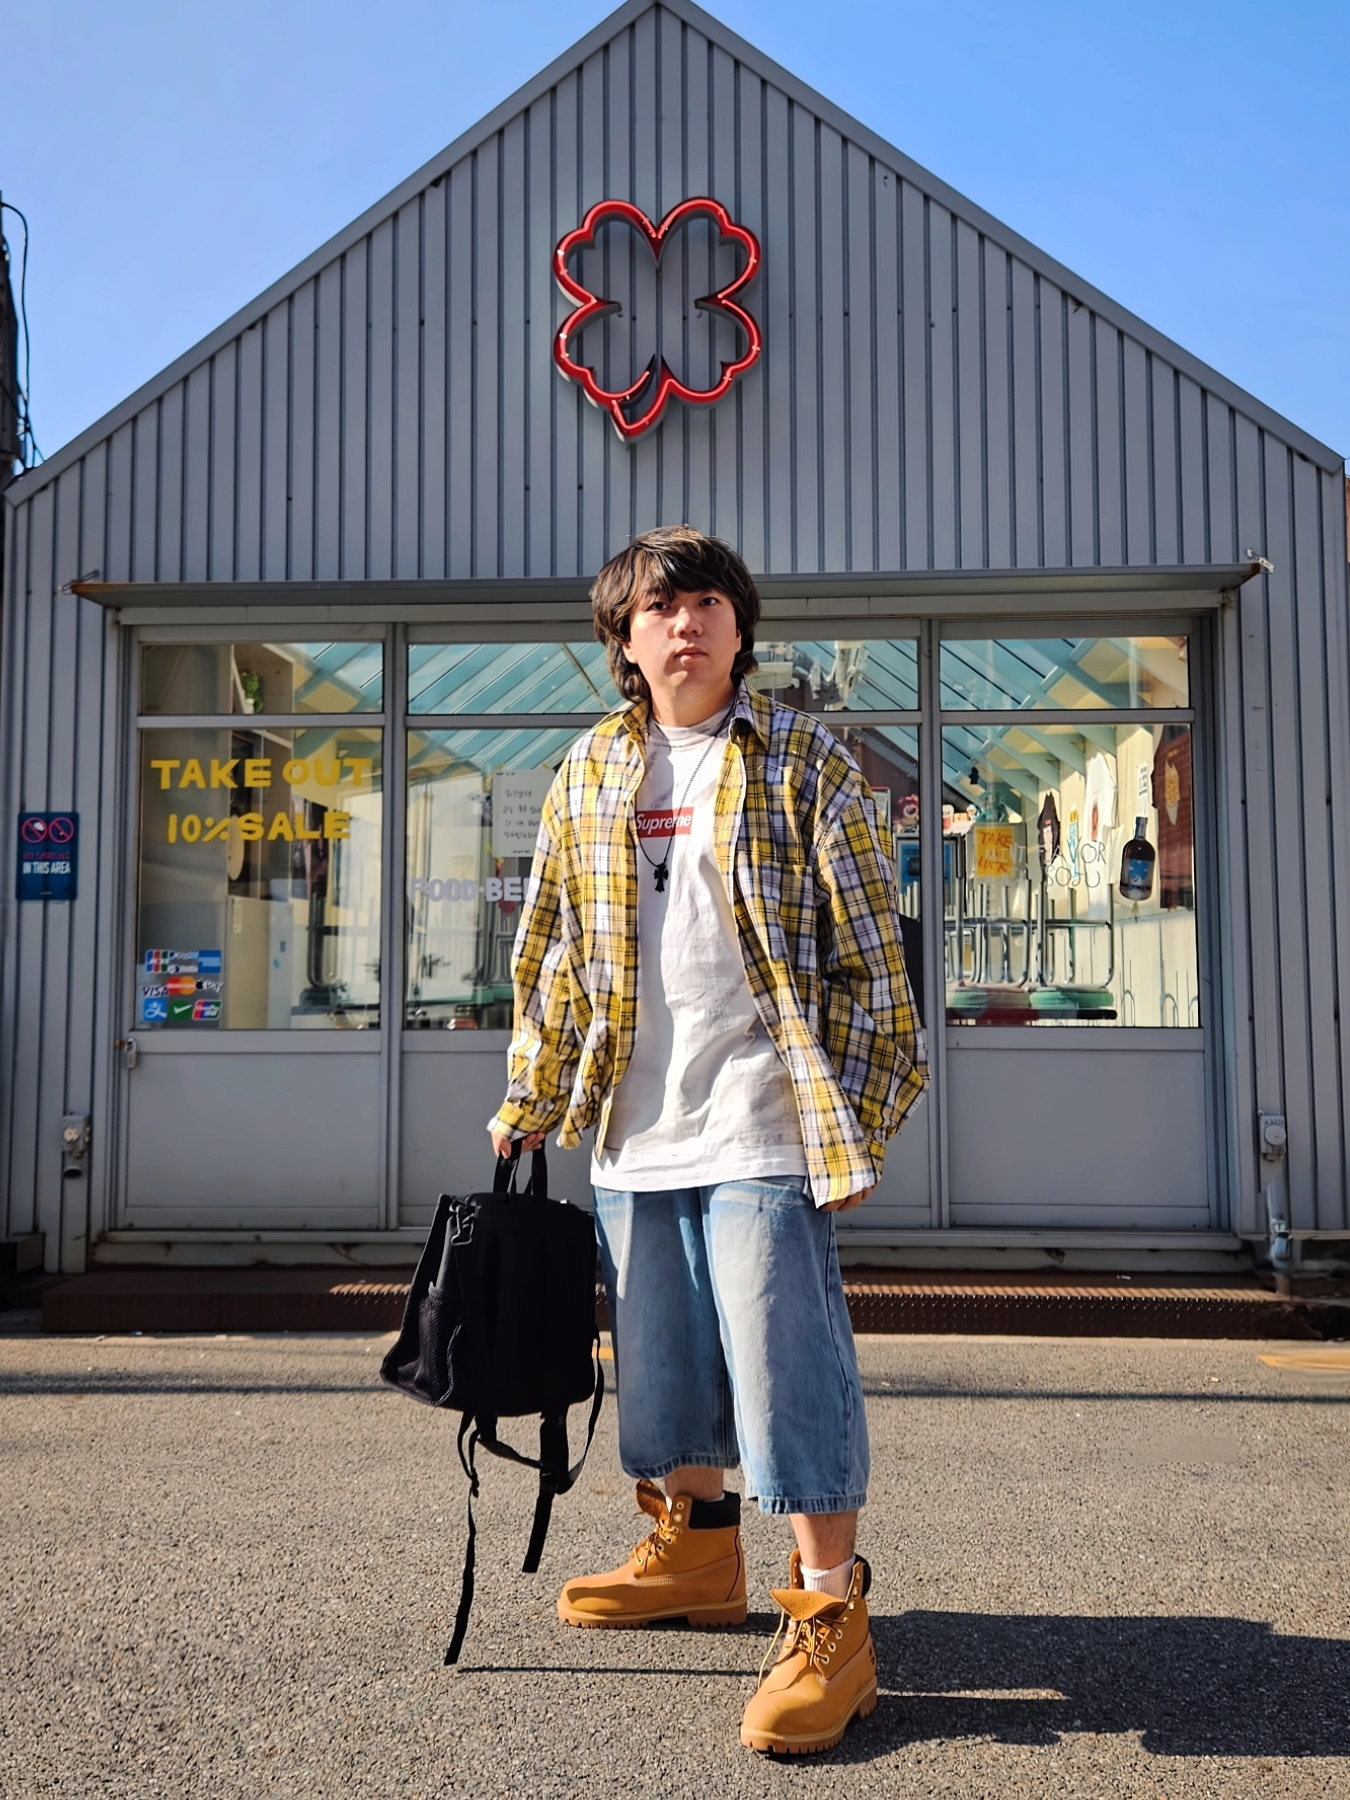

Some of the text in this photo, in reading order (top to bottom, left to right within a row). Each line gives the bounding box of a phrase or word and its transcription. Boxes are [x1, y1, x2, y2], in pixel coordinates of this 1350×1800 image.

[151, 758, 372, 790] TAKE OUT
[637, 813, 691, 835] Supreme
[979, 831, 1013, 850] TAKE
[22, 861, 70, 875] IN THIS AREA
[143, 986, 169, 997] VISA
